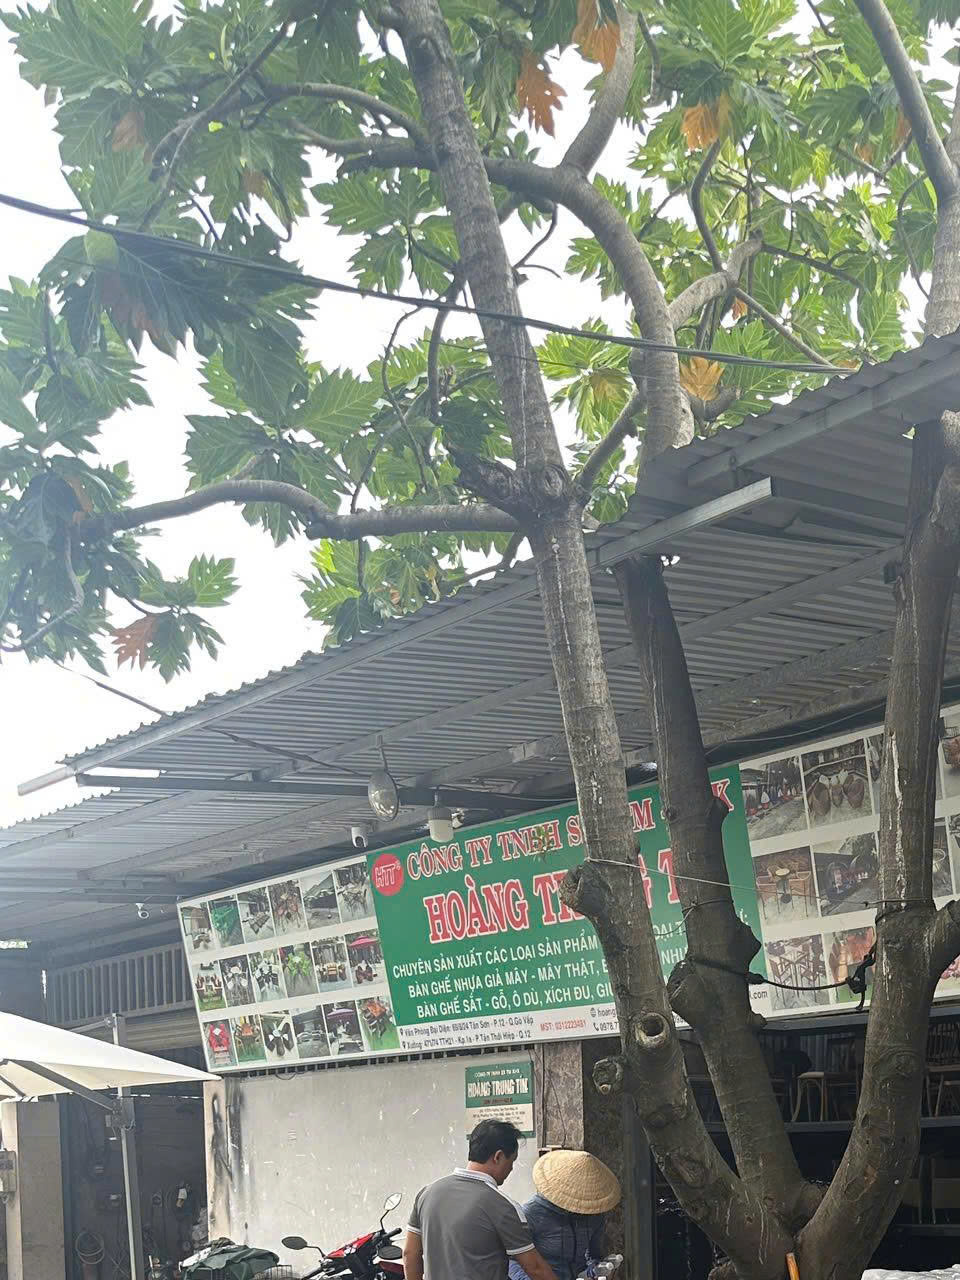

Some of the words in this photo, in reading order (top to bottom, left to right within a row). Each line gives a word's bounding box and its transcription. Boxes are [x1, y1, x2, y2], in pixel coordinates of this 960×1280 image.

[406, 842, 463, 880] CÔNG
[464, 835, 493, 868] TY
[423, 874, 530, 944] HOÀNG
[392, 958, 432, 978] CHUYÊN
[433, 953, 455, 973] SẢN
[455, 947, 483, 970] XUẤT
[485, 945, 508, 965] CÁC
[510, 945, 536, 964] LOẠI
[537, 937, 562, 958] SẢN
[564, 929, 599, 953] PHẨM
[408, 980, 430, 999] BÀN
[430, 974, 453, 995] GHẾ
[454, 973, 483, 994] NHỰA
[484, 968, 503, 990] GIẢ
[504, 968, 529, 987] MÂY
[537, 963, 563, 983] MÂY
[564, 957, 601, 979] THẬT,
[416, 1001, 439, 1018] BÀN
[439, 995, 461, 1016] GHẾ
[463, 993, 482, 1013] SẮT
[491, 988, 511, 1012] GỖ,
[512, 989, 522, 1008] Ô
[544, 983, 572, 1004] XÍCH
[491, 1079, 515, 1096] TRUNG
